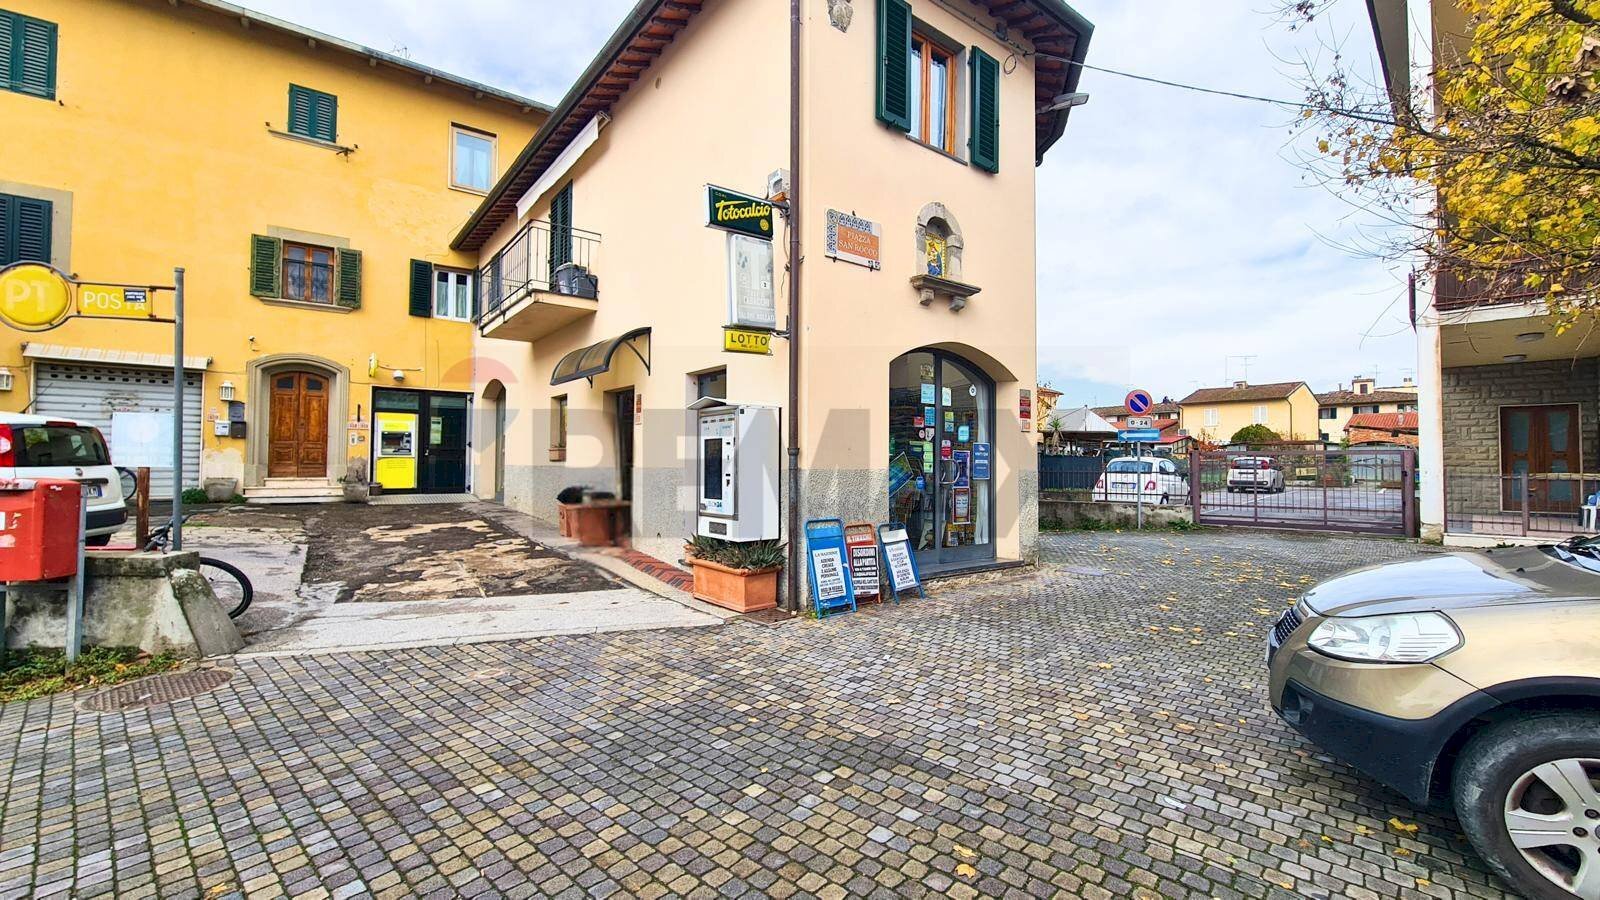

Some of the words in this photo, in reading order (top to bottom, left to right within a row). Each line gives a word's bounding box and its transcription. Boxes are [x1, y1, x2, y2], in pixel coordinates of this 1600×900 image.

[715, 200, 771, 221] Totocalcio
[847, 231, 871, 244] PIAZZA
[838, 240, 853, 250] SAN
[854, 243, 878, 257] ROCCO
[6, 279, 52, 313] PT
[730, 333, 768, 346] LOTTO
